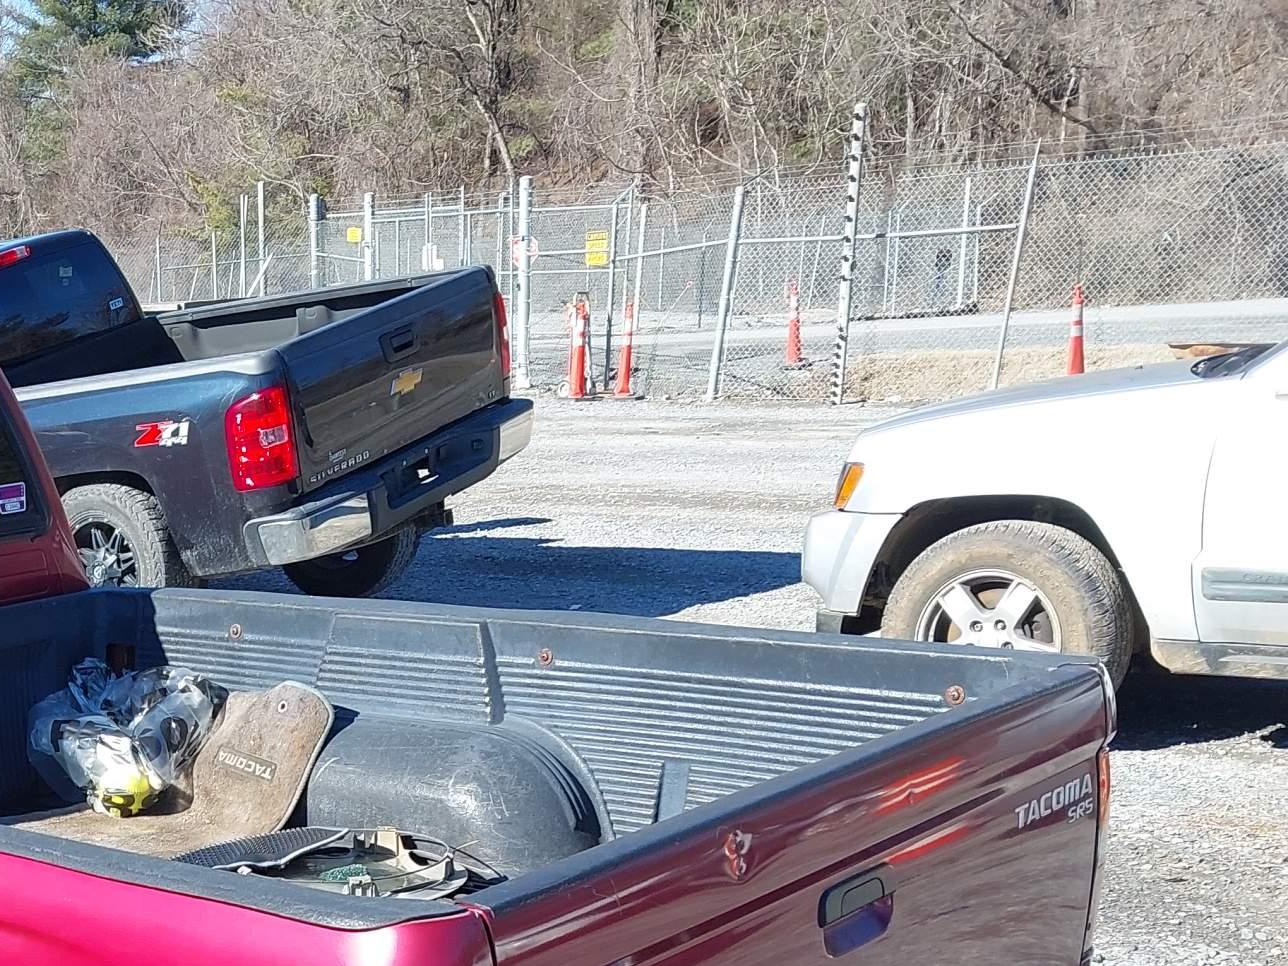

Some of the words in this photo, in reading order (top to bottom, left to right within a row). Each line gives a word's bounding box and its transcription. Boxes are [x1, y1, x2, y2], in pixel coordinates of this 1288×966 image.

[134, 420, 190, 447] Z71
[310, 450, 370, 483] SILVERADO
[218, 751, 274, 780] TACOMA
[1014, 773, 1092, 829] TACOMA
[1068, 797, 1093, 823] SR5
